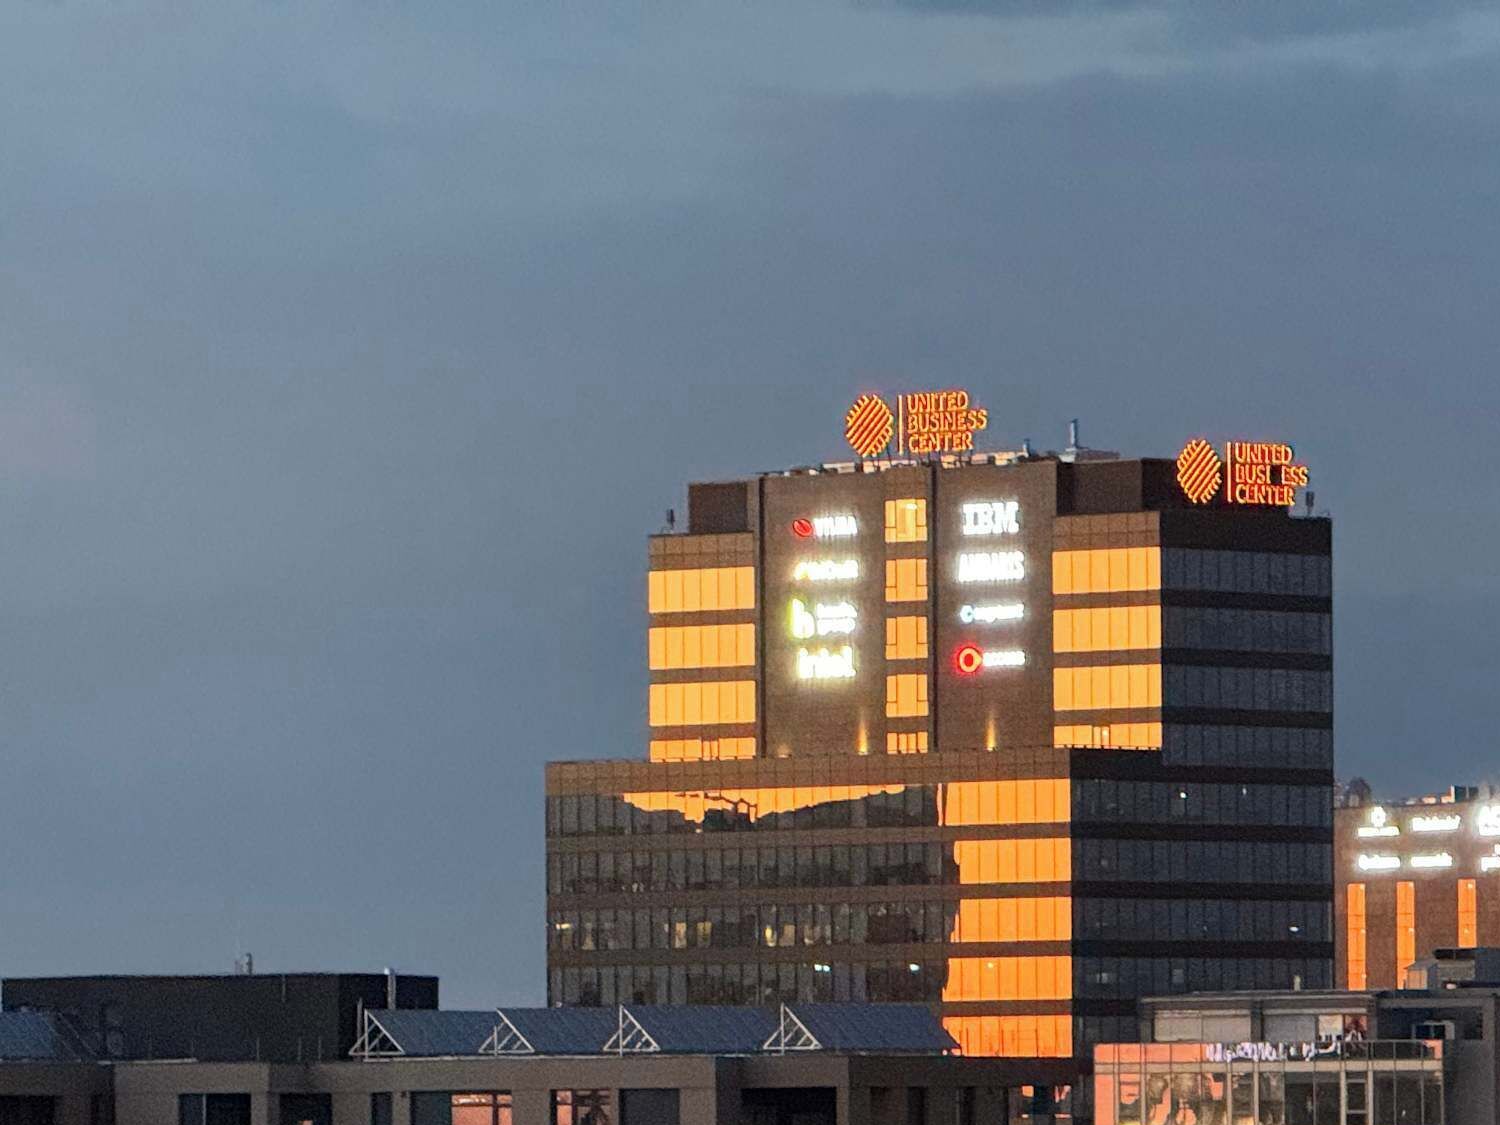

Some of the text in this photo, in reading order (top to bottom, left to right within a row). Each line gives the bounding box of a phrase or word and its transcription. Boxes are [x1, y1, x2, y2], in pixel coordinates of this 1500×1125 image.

[907, 391, 969, 413] UNITED
[907, 409, 988, 433] BUSINESS
[908, 432, 973, 453] CENTER
[1235, 442, 1293, 465] UNITED
[1235, 464, 1308, 486] BUSIESS
[1235, 484, 1295, 506] CENTER
[962, 501, 1019, 535] IBM
